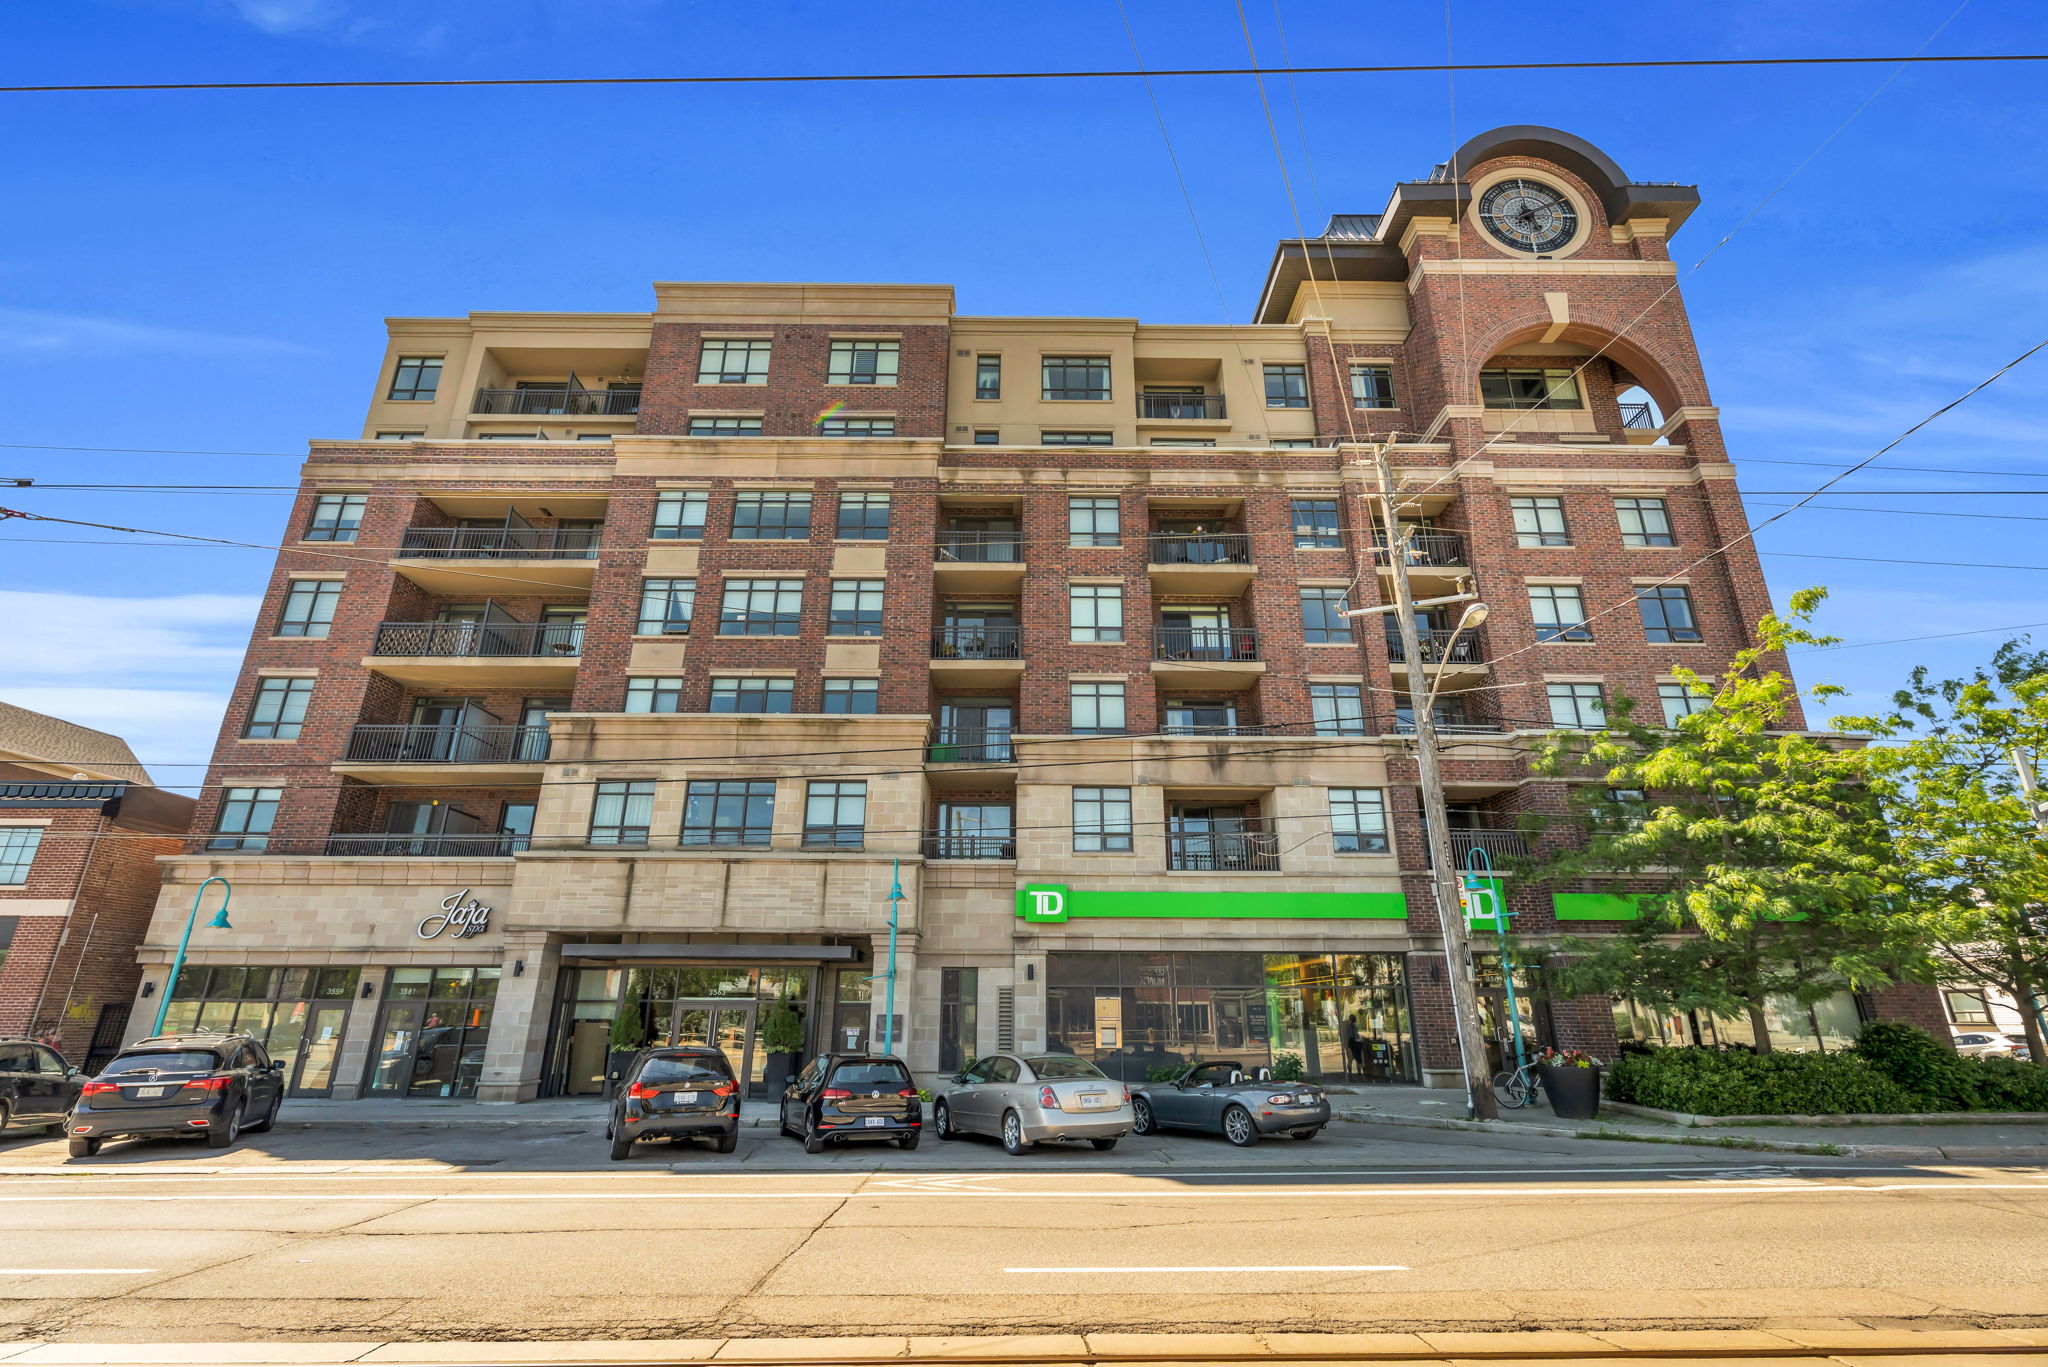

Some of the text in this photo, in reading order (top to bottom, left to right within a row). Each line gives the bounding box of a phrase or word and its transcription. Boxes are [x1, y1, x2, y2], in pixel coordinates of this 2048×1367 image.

[417, 888, 491, 939] Jaja
[1029, 891, 1063, 915] TD
[466, 923, 485, 938] spa
